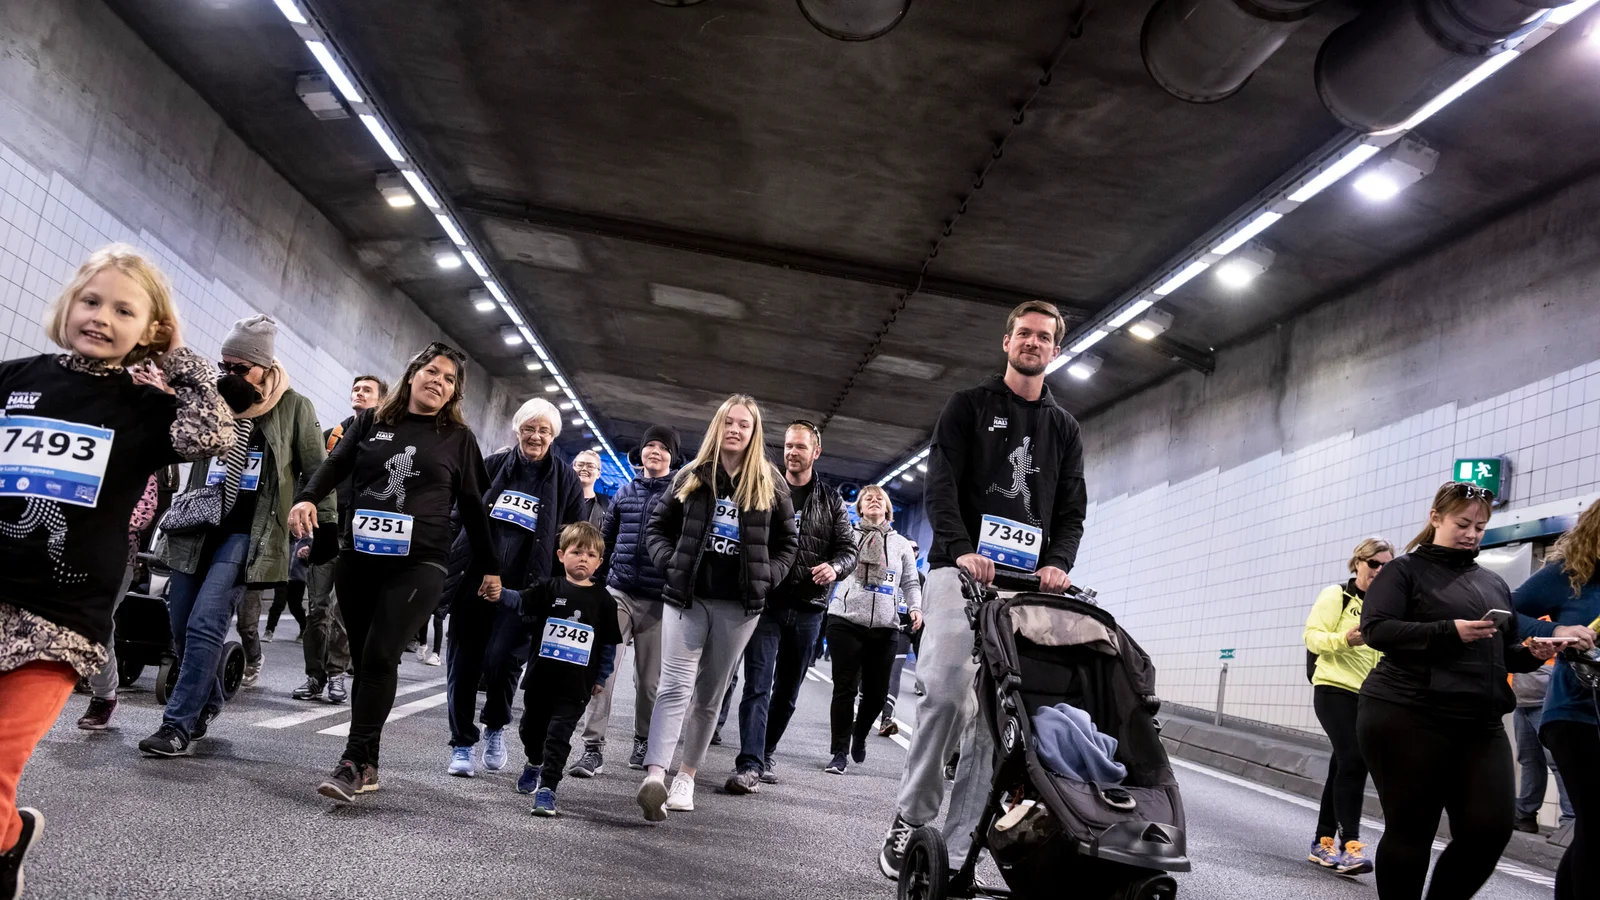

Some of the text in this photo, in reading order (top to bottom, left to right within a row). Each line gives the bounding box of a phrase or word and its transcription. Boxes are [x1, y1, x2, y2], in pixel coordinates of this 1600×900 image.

[7, 395, 40, 405] HALV
[3, 427, 97, 462] 7493
[502, 494, 540, 515] 9156
[358, 516, 405, 534] 7351
[988, 522, 1036, 547] 7349
[548, 623, 589, 644] 7348
